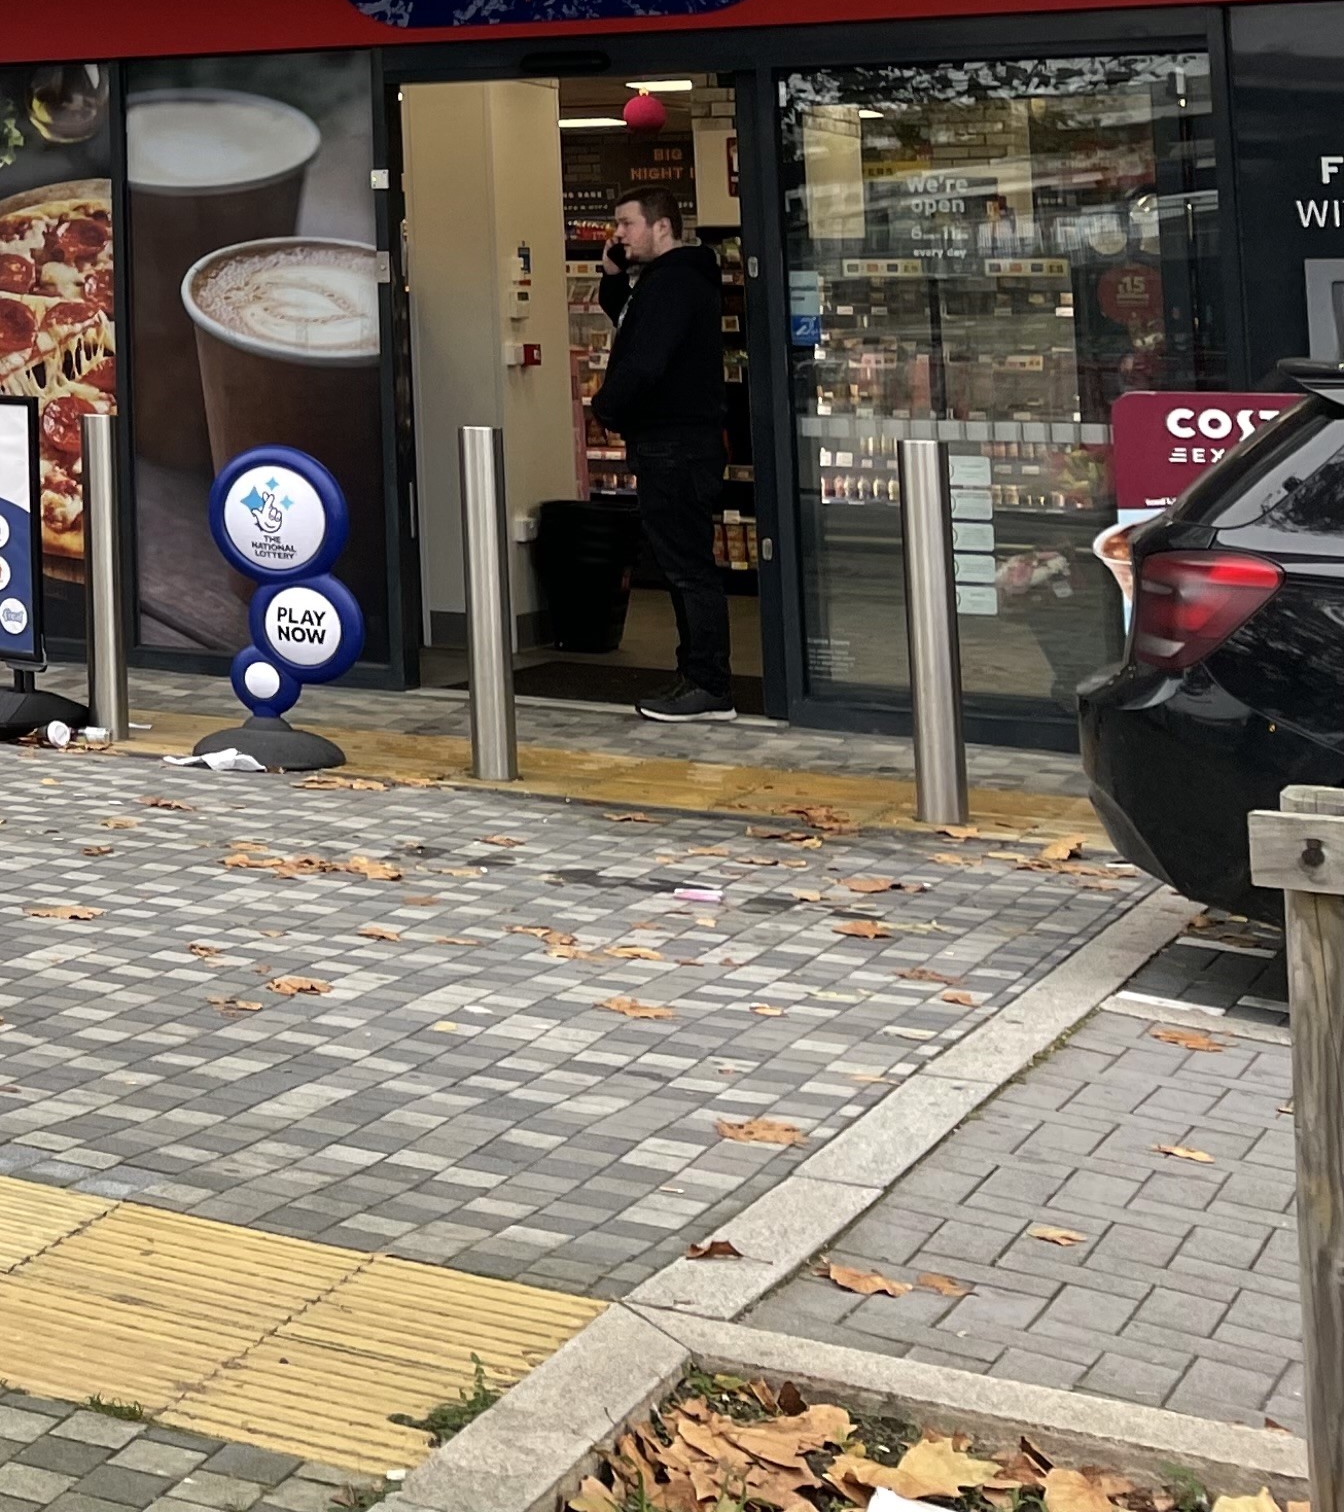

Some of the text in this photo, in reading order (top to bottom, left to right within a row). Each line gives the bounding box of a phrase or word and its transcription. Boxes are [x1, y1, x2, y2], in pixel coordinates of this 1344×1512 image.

[631, 167, 683, 180] NIGHT
[906, 176, 968, 193] We're
[912, 198, 965, 216] open
[1295, 200, 1344, 228] WI
[251, 542, 297, 554] NATIONAL
[263, 535, 281, 544] THE
[254, 550, 295, 560] LOTTERY
[277, 607, 327, 627] PLAY
[277, 626, 327, 645] NOW
